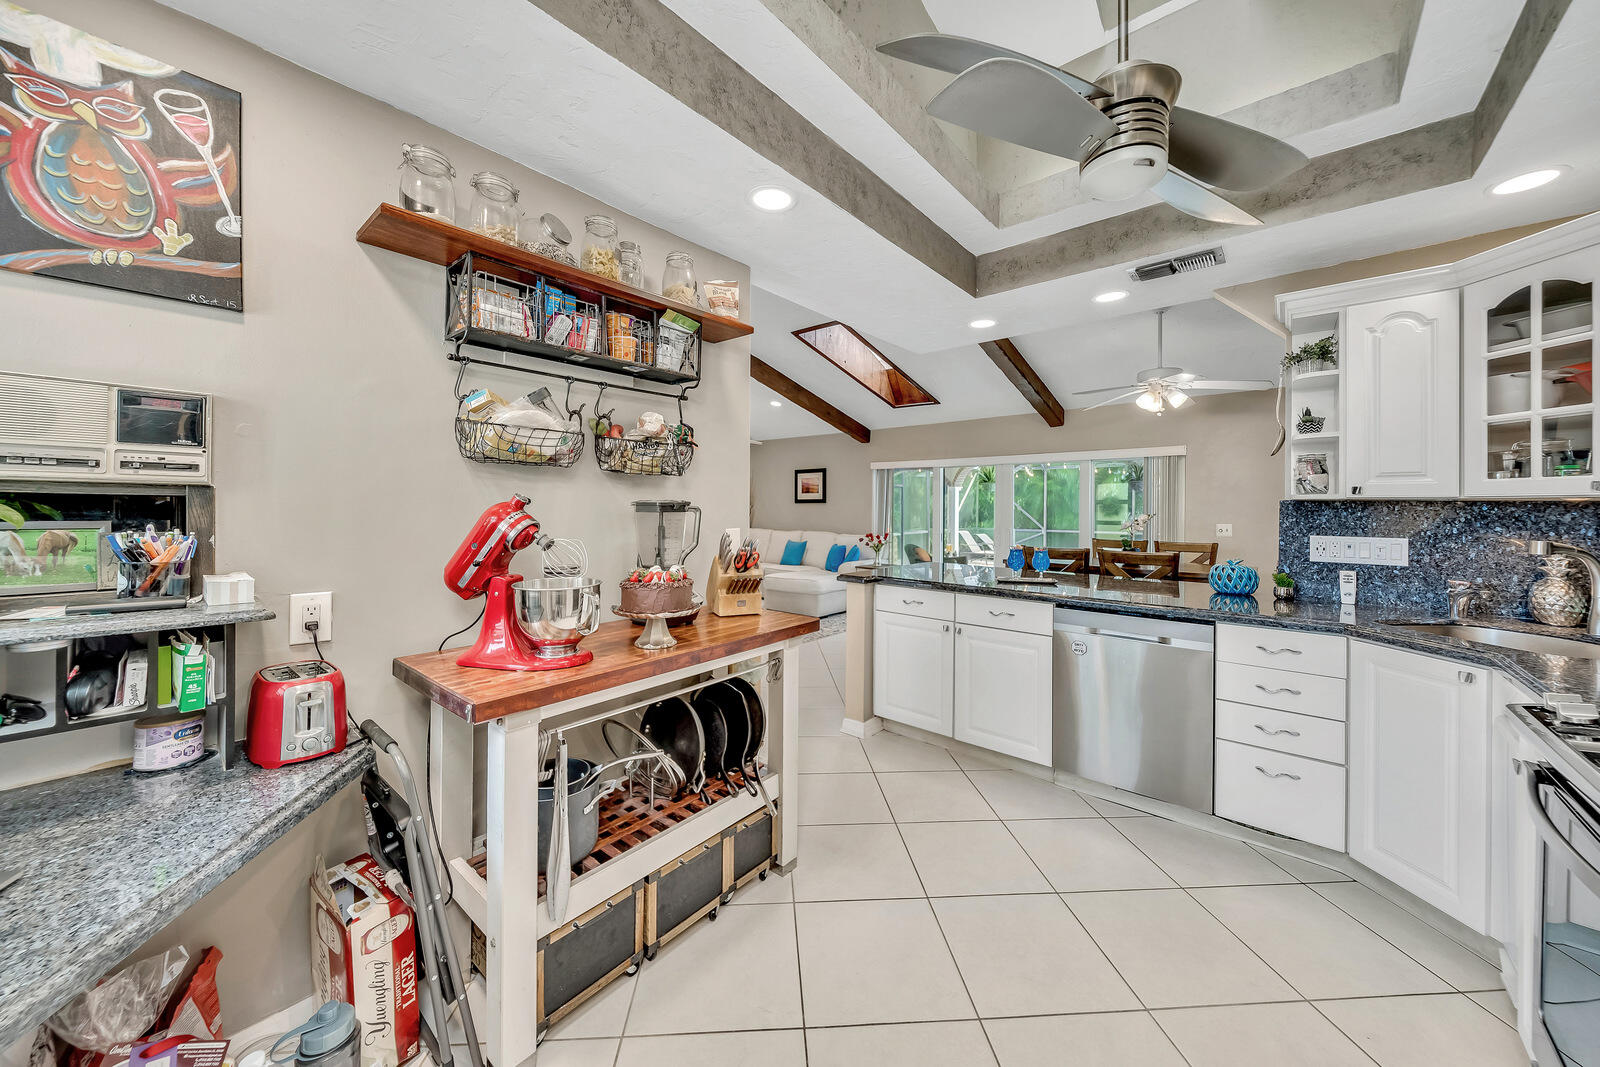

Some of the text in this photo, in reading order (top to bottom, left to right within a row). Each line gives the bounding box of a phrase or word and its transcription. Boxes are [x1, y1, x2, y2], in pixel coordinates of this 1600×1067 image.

[364, 959, 392, 1047] Yuengling
[394, 965, 402, 1009] TRADITIONAL
[401, 950, 417, 1010] LAGER
